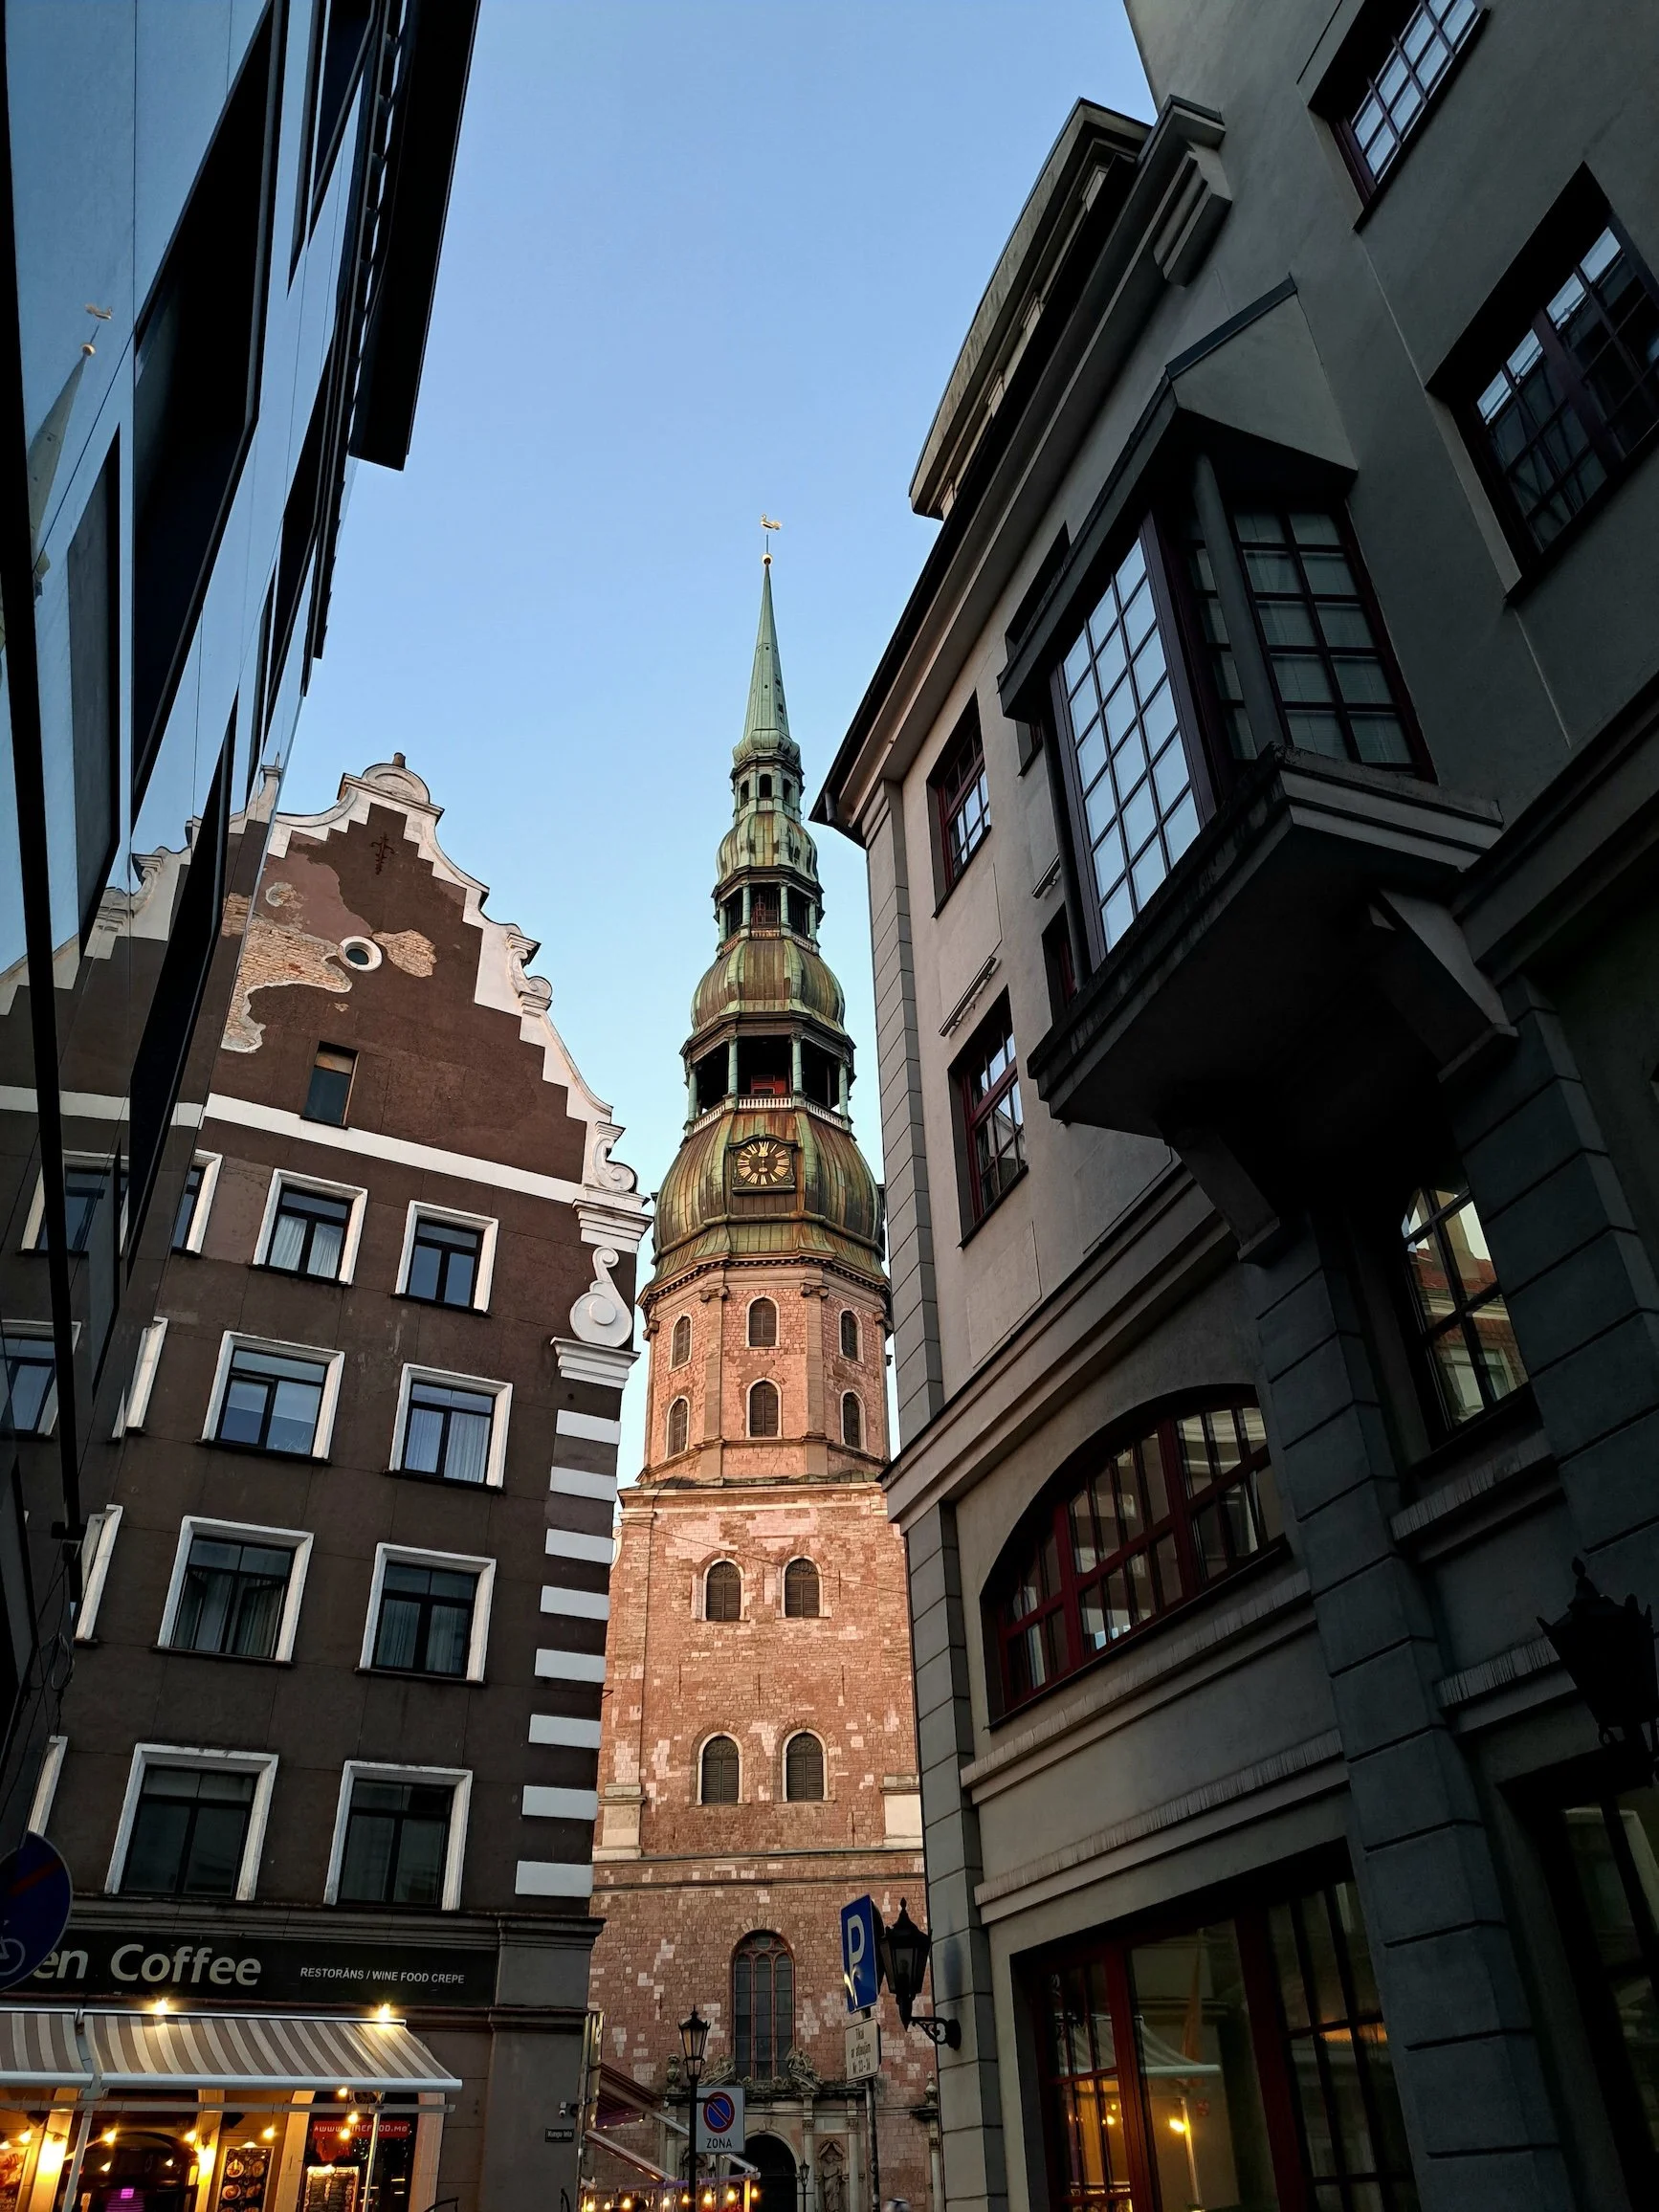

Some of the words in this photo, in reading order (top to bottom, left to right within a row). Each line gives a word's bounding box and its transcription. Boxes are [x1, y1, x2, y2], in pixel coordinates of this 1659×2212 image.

[110, 1943, 261, 1986] Coffee
[848, 1914, 865, 1997] P
[300, 1967, 365, 1980] RESTORĀNS
[372, 1970, 398, 1981] WINE
[400, 1972, 429, 1982] FOOD
[431, 1973, 465, 1984] CREPE
[706, 2137, 733, 2149] ZONA
